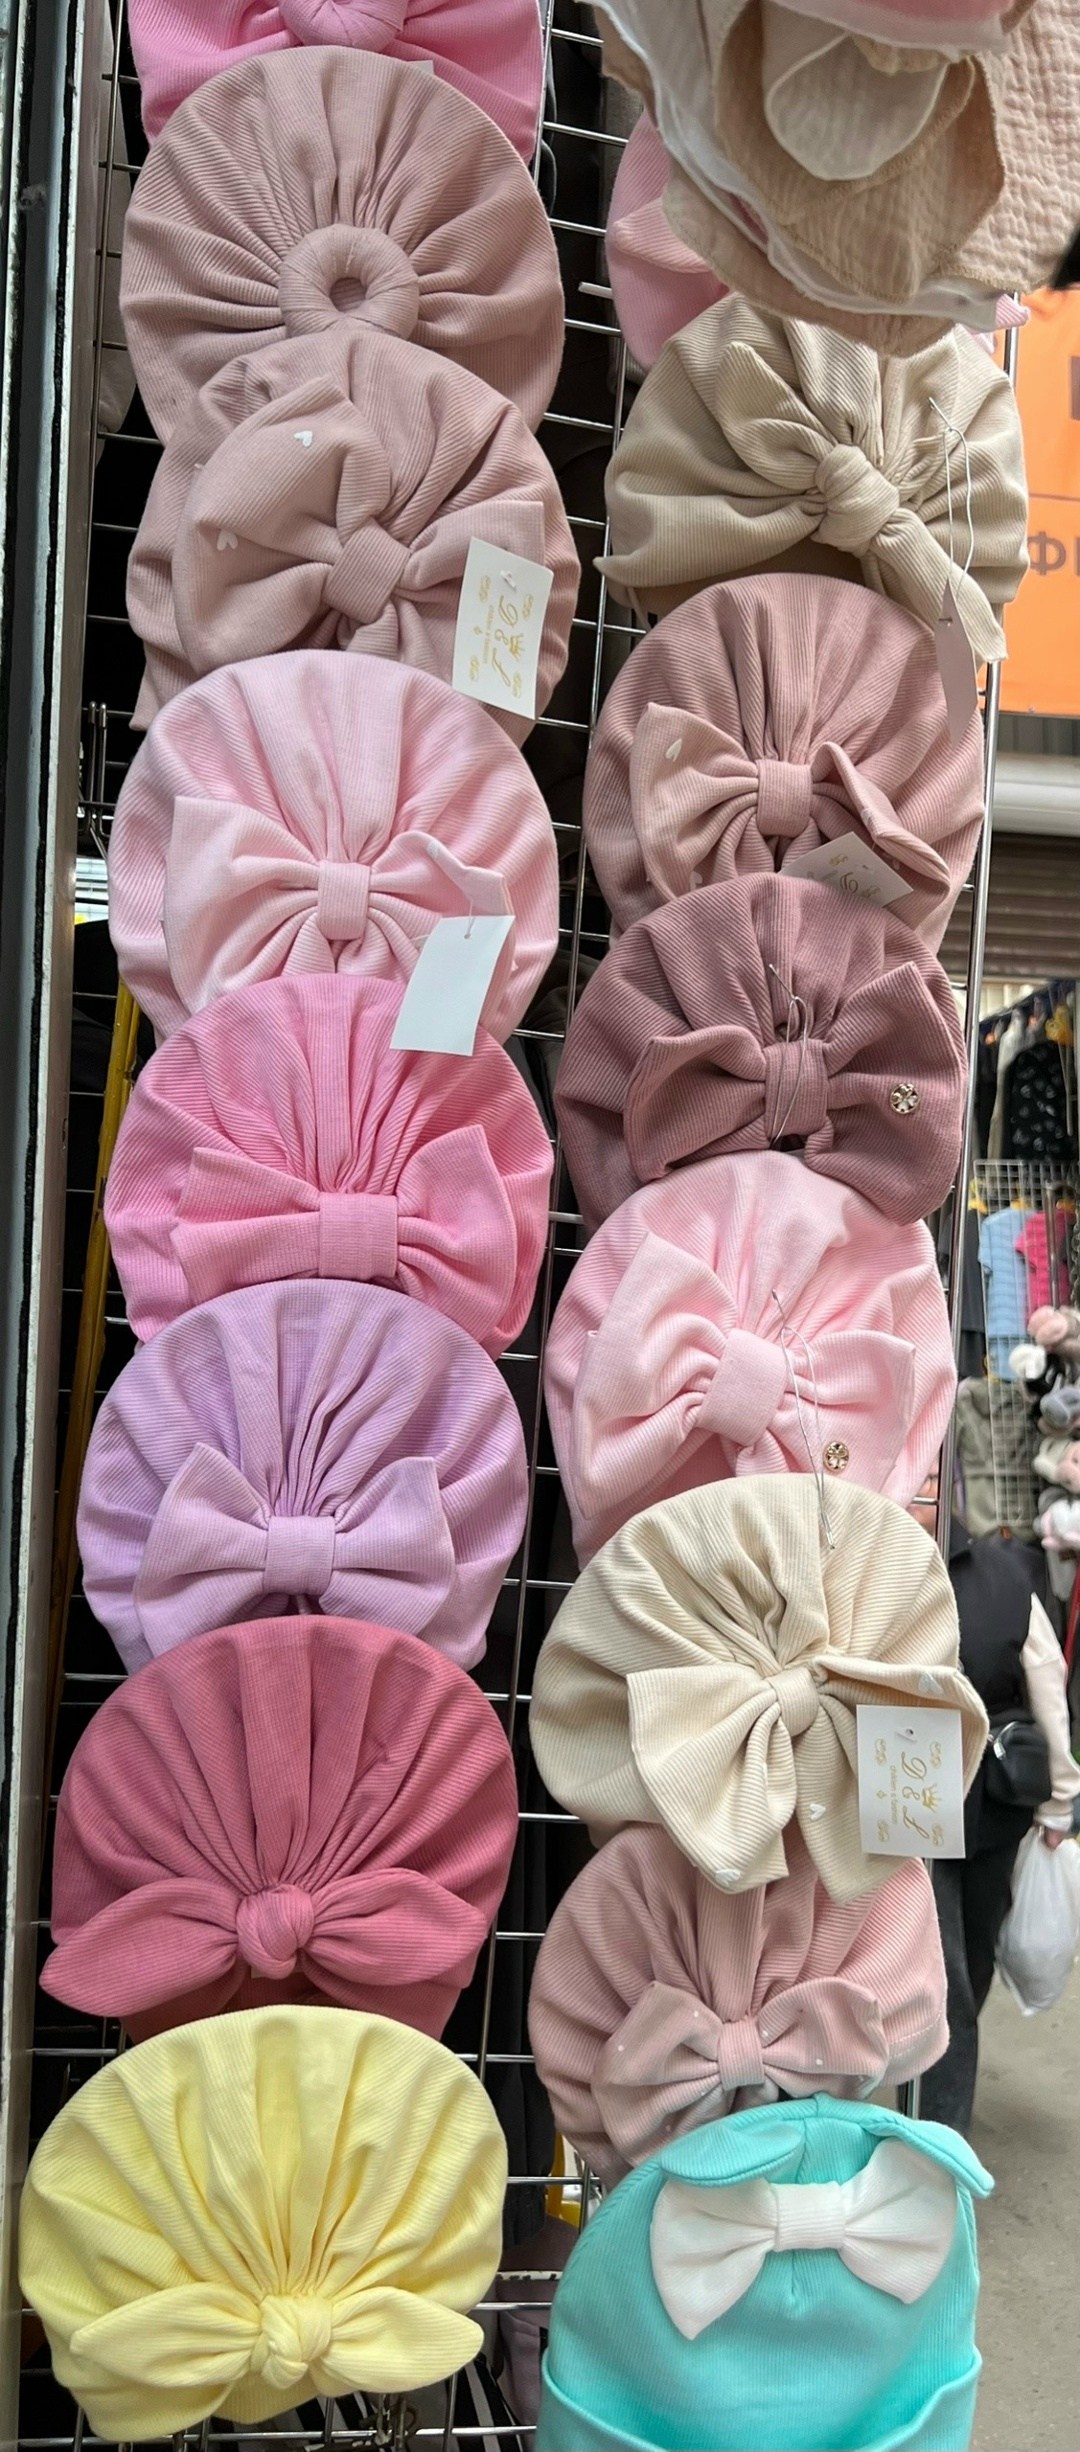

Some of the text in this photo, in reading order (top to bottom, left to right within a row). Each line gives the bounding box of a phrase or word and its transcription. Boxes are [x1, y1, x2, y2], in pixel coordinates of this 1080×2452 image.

[499, 595, 518, 627] D
[901, 1751, 930, 1839] D & L
